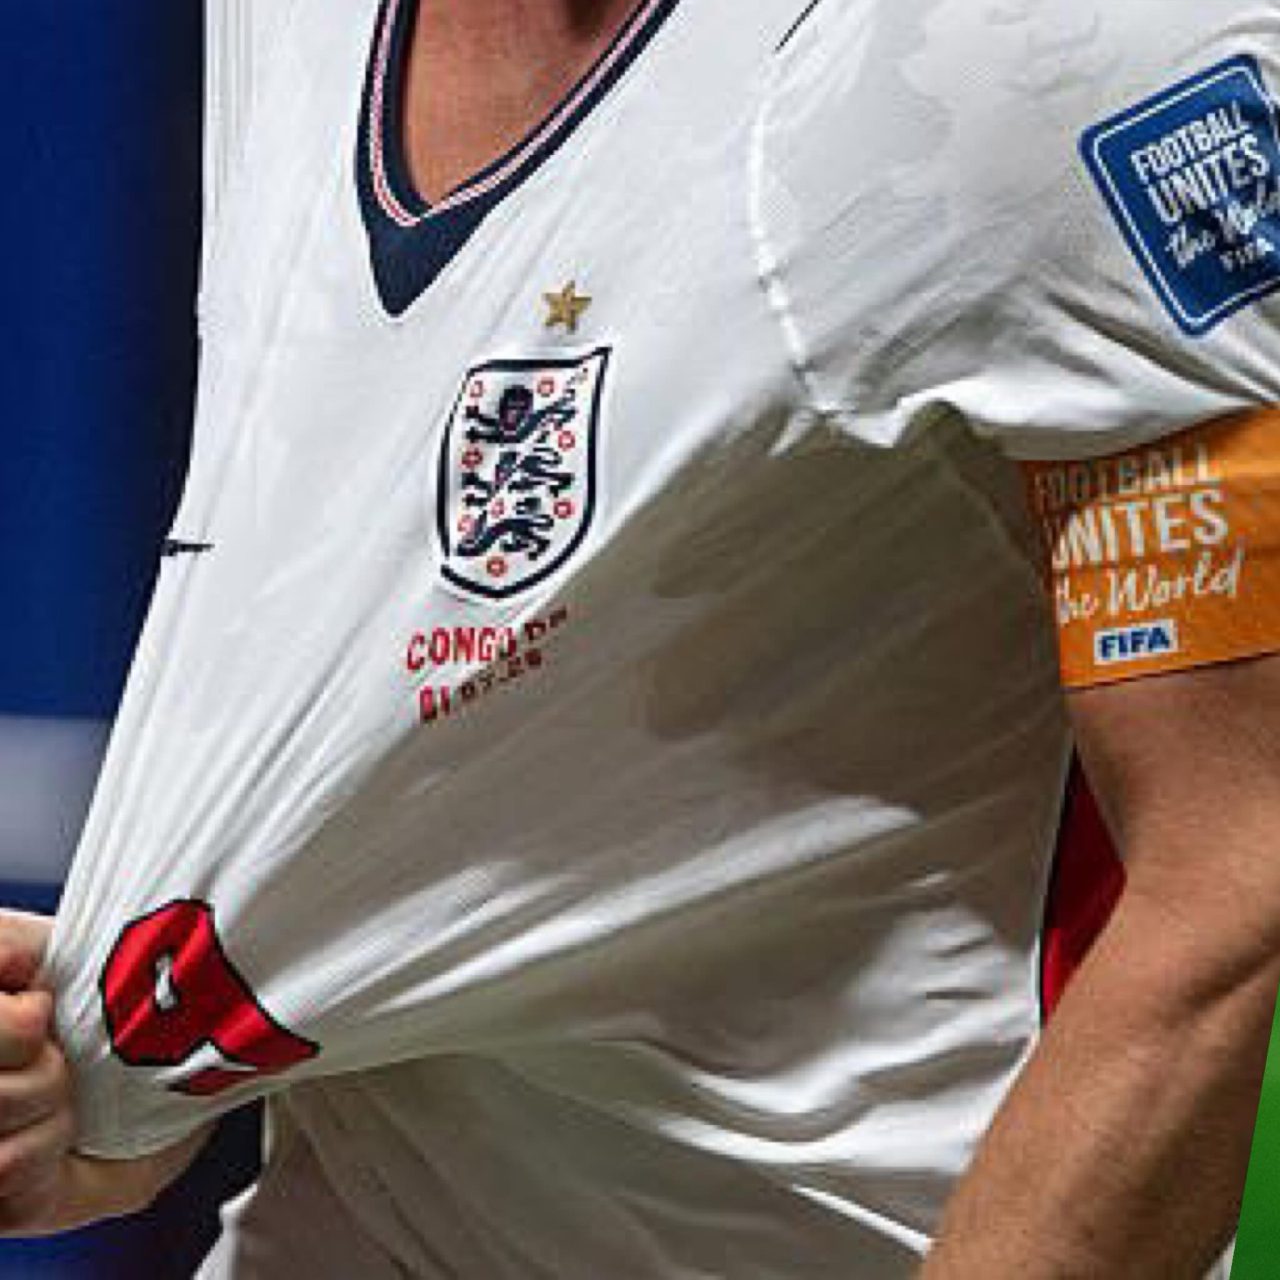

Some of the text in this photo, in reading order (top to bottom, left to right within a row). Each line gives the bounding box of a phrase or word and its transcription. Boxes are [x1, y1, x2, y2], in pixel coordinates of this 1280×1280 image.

[1130, 99, 1251, 185] FOOTBALL
[1147, 132, 1271, 224] UNITES
[1105, 535, 1247, 616] World
[406, 626, 517, 672] CONGO
[1100, 626, 1171, 659] FIFA
